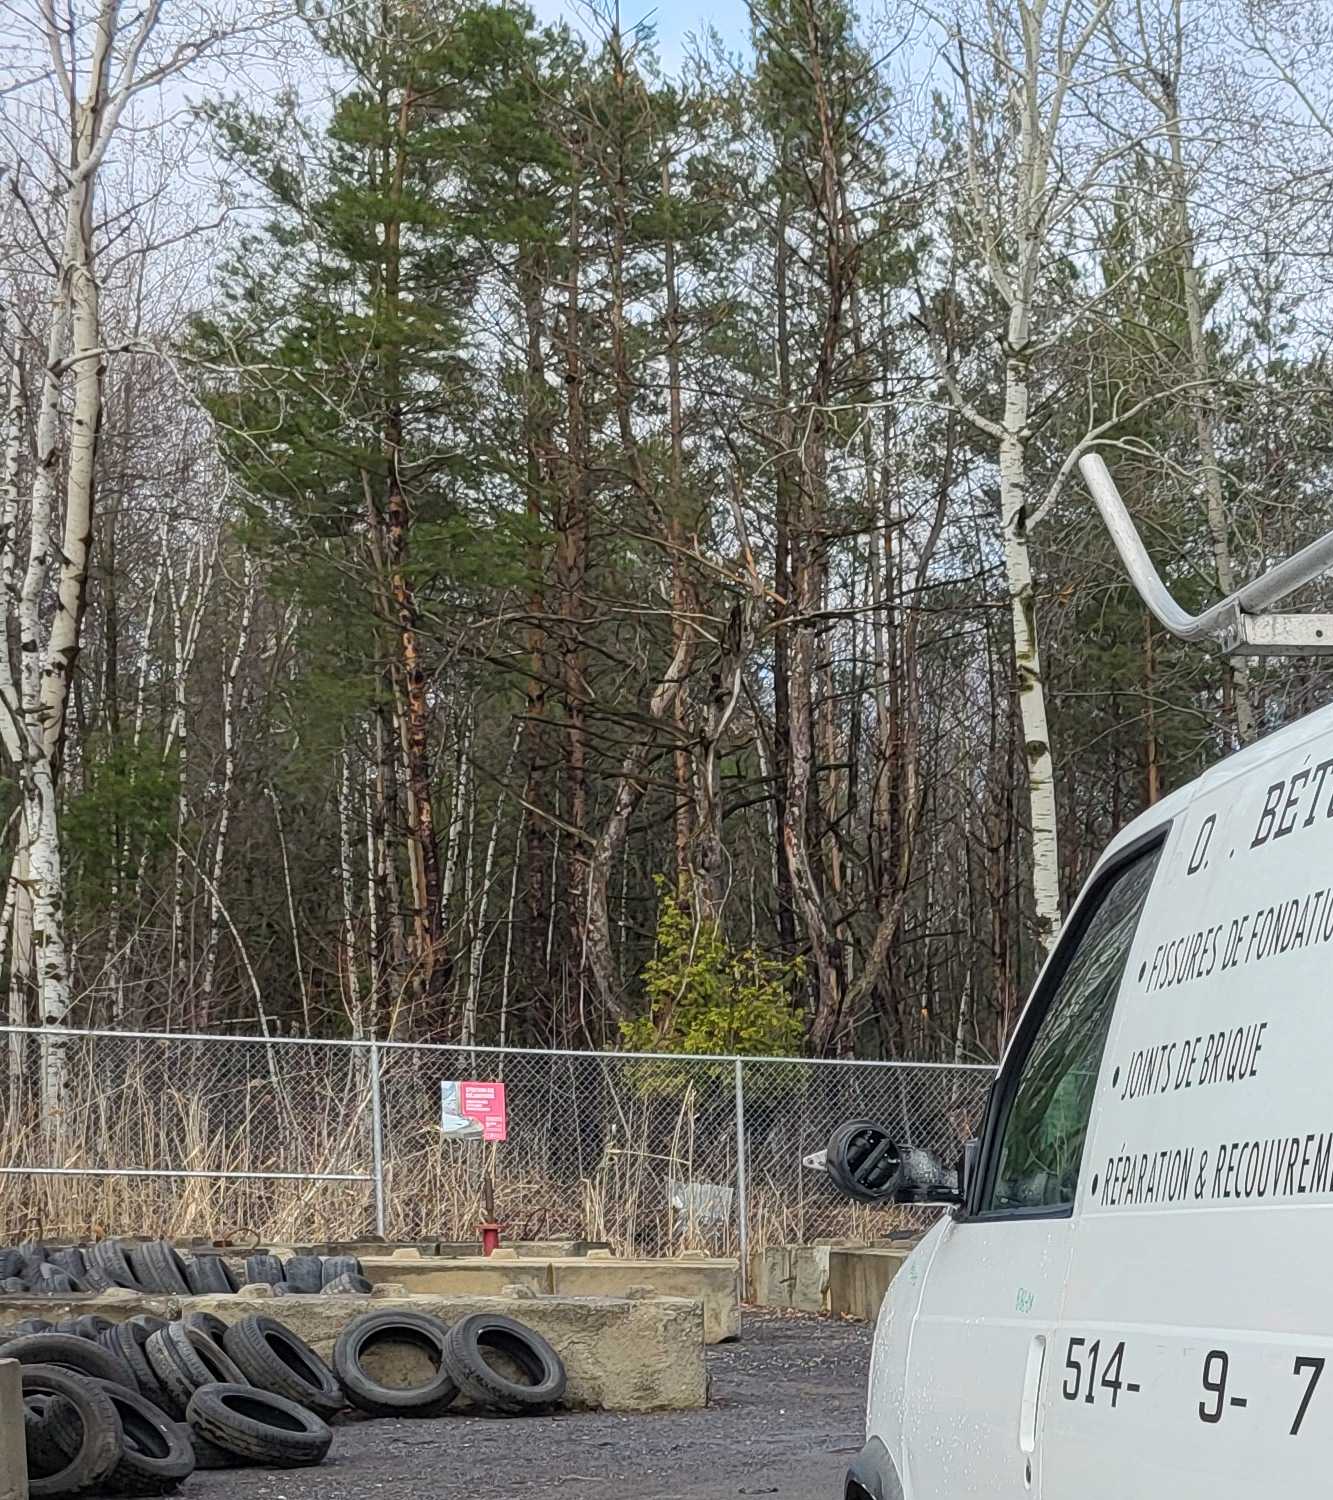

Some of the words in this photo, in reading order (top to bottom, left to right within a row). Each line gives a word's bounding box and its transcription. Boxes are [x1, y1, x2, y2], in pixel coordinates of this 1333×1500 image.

[1146, 924, 1224, 993] FISSURES
[1221, 915, 1249, 971] DE
[1121, 1042, 1177, 1101] JOINTS
[1174, 1037, 1202, 1091] DE
[1198, 1022, 1268, 1085] BRIQUE
[1101, 1143, 1195, 1206] RÉPARATION
[1194, 1150, 1209, 1200] &
[1062, 1337, 1140, 1408] 514-
[1199, 1350, 1248, 1424] 9-
[1289, 1356, 1326, 1436] 7
